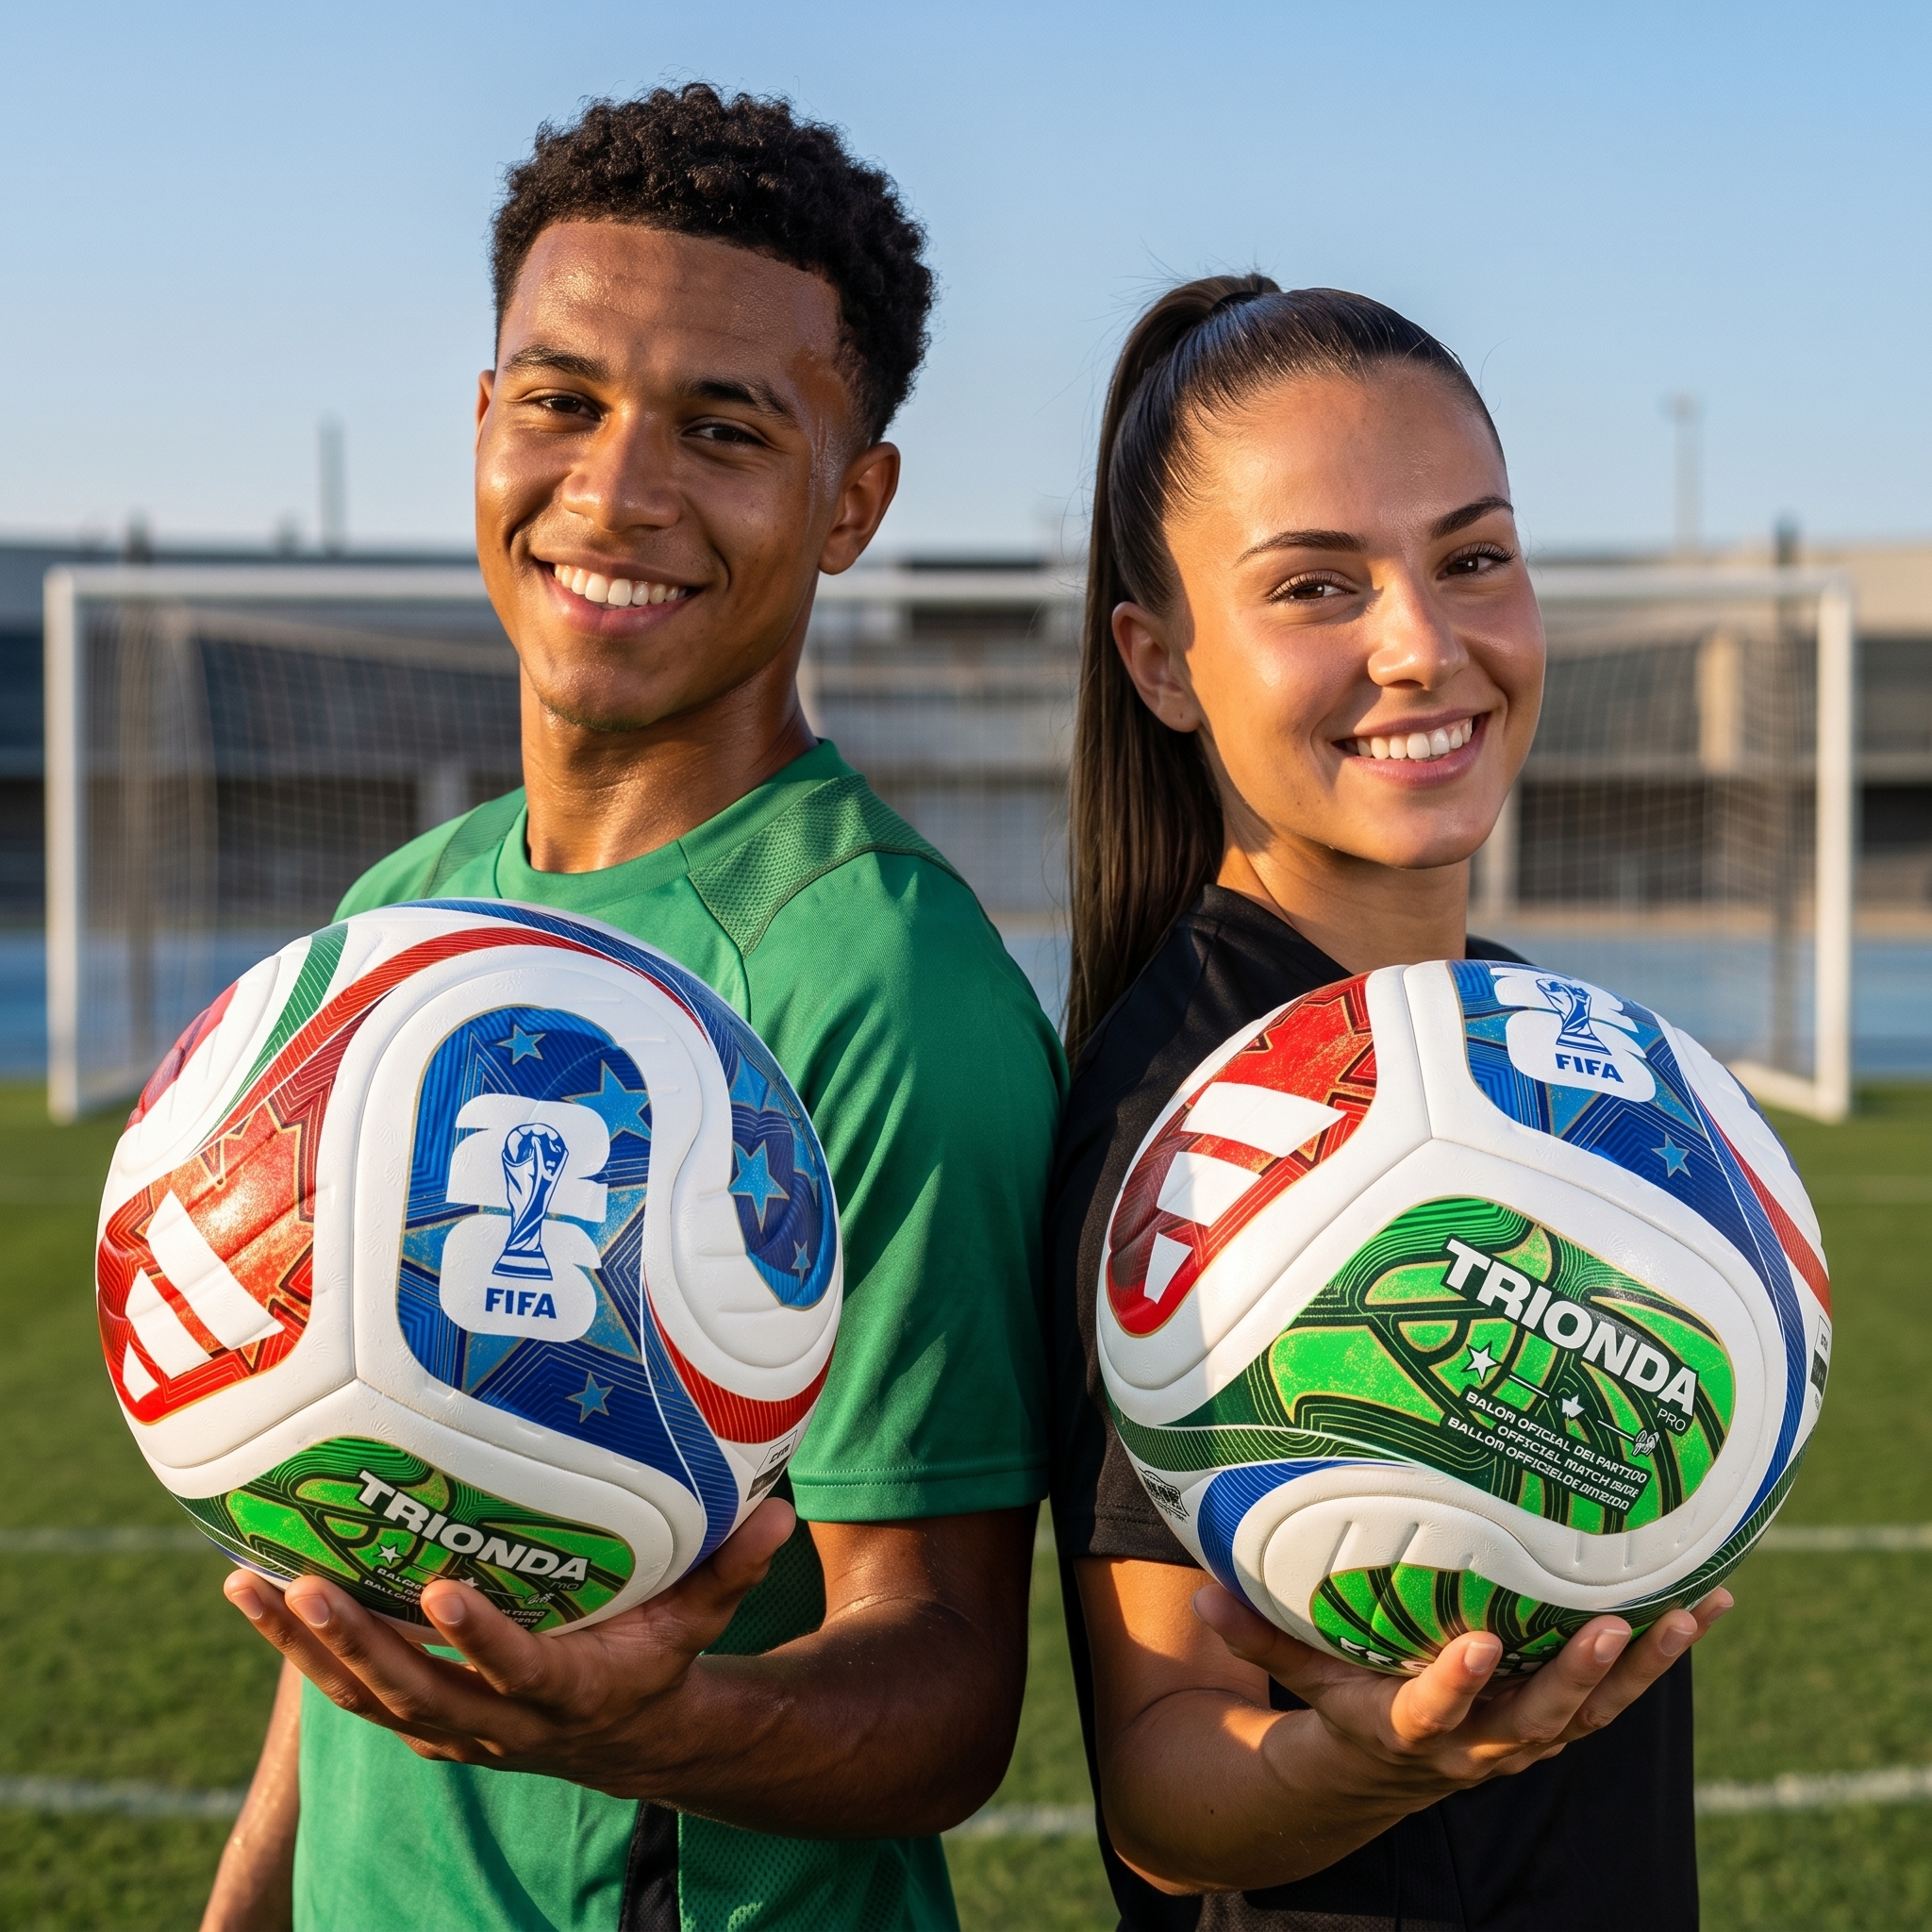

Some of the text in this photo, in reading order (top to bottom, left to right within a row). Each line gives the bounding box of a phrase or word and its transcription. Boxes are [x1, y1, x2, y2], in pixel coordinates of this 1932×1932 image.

[1555, 1053, 1624, 1083] FIFA
[485, 1288, 557, 1319] FIFA
[1446, 1239, 1697, 1416] TRIONDA
[1657, 1408, 1686, 1431] PRO
[1564, 1458, 1611, 1486] MATCH
[358, 1470, 589, 1581] TRIONDA
